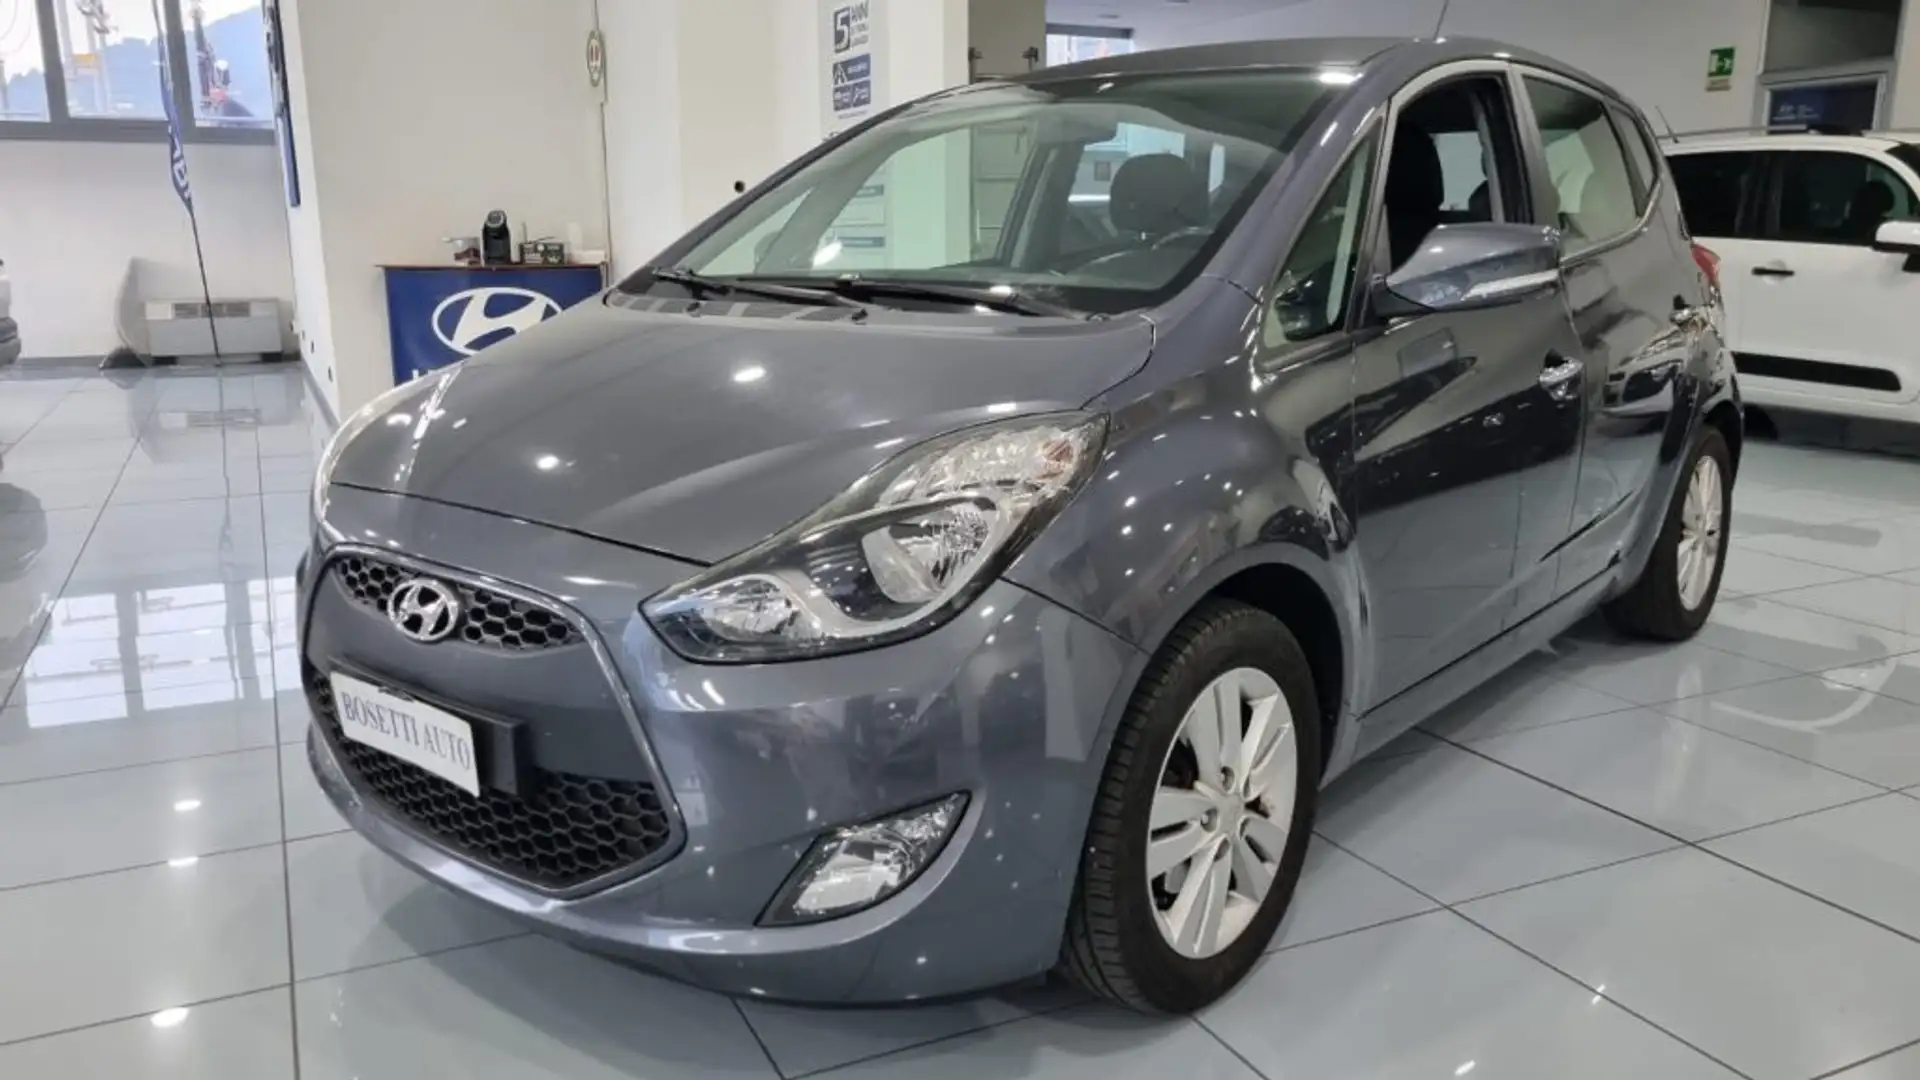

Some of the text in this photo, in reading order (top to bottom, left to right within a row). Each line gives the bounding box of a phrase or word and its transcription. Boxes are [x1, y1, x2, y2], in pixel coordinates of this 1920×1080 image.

[835, 10, 849, 50] 5
[341, 691, 471, 771] BOSETTI AUTO
